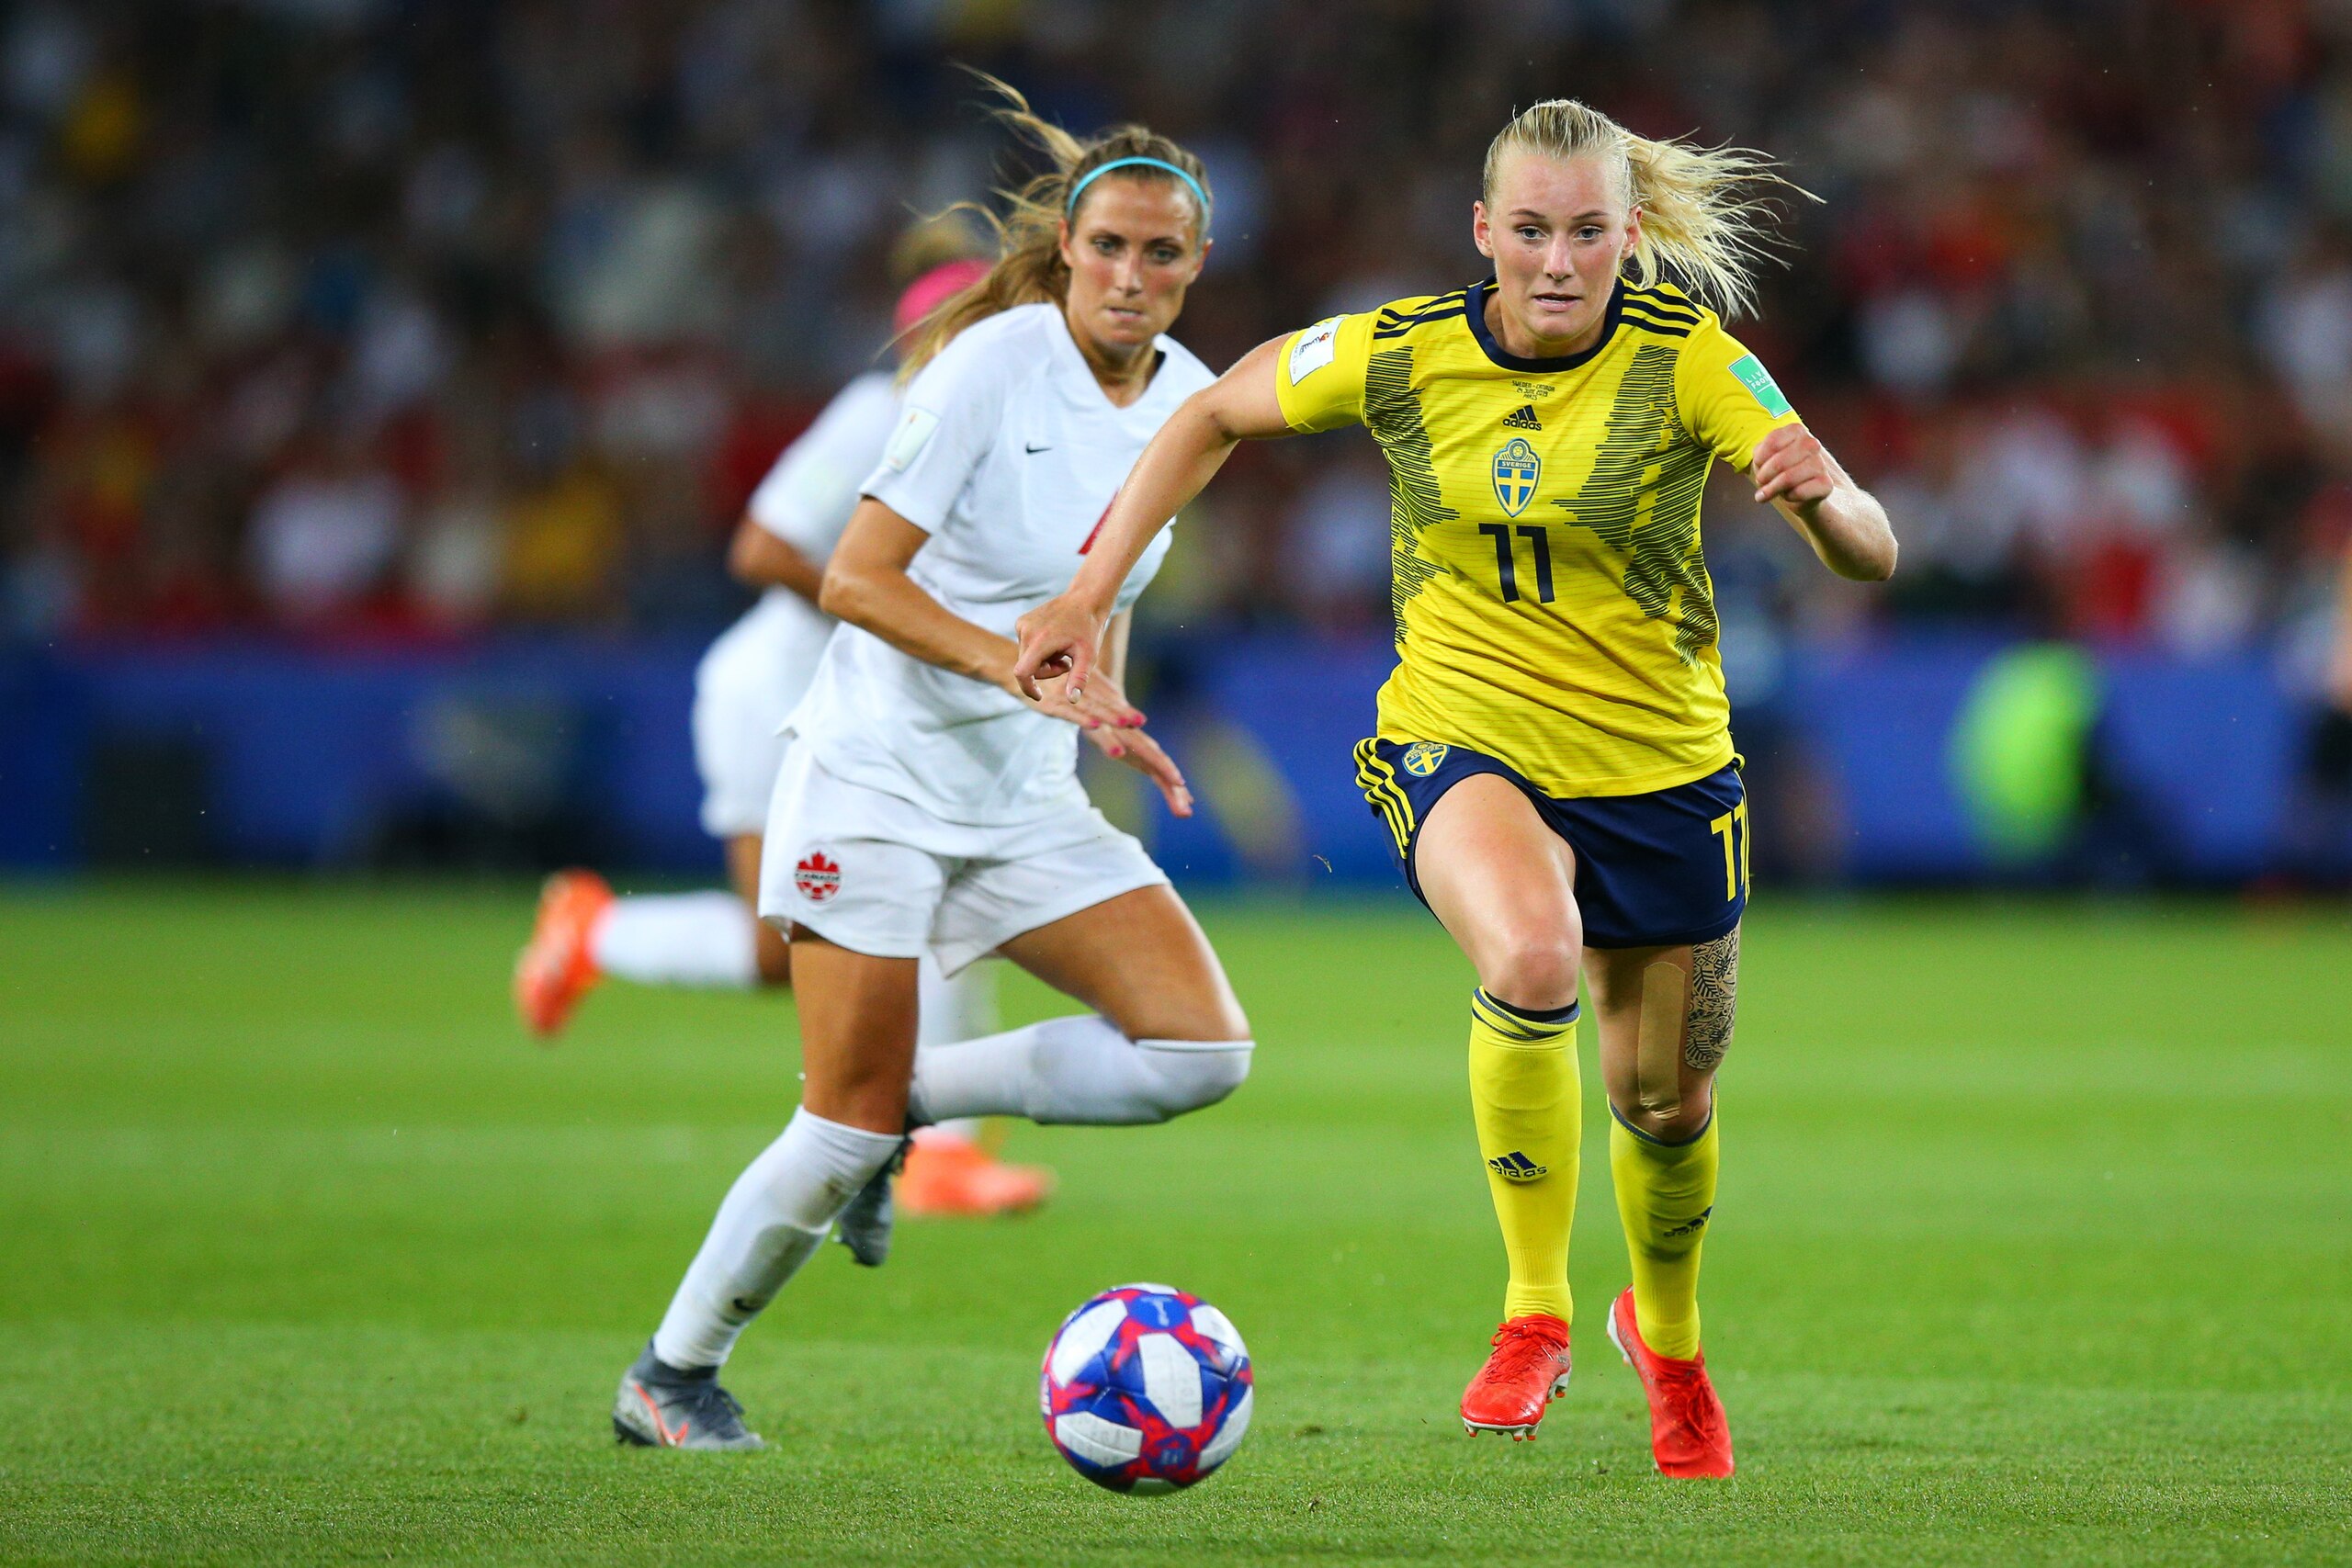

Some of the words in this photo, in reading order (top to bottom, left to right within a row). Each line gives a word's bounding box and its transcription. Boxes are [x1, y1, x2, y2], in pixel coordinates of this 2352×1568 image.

[1512, 380, 1532, 389] SWEDEN
[1503, 418, 1542, 431] adidas
[1501, 460, 1532, 468] SVERIGE
[1478, 523, 1555, 604] 11
[1710, 796, 1746, 902] 11
